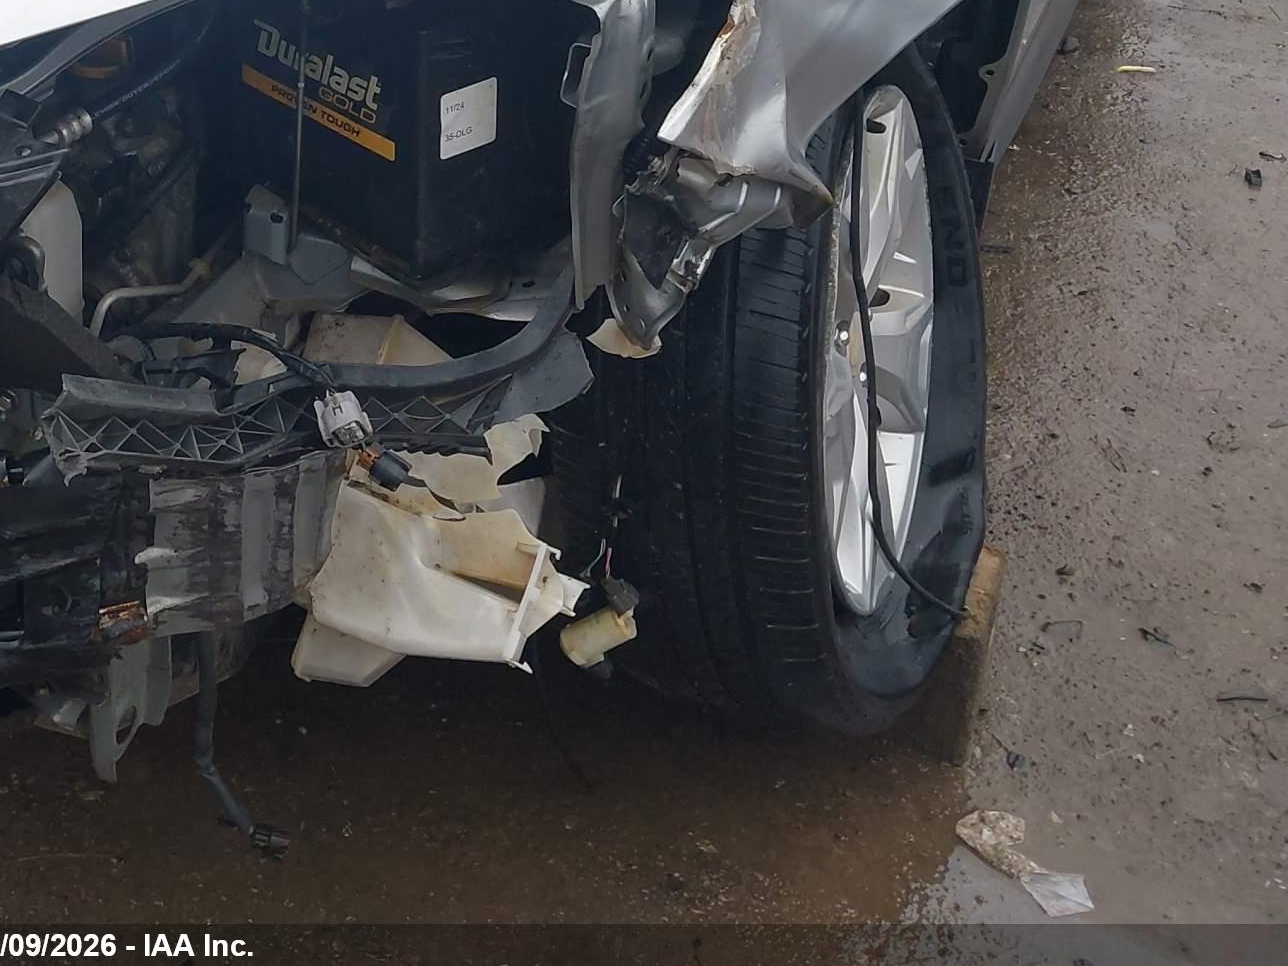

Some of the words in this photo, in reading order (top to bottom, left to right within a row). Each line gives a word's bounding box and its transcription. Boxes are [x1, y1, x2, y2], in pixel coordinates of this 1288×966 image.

[253, 18, 383, 111] Duralast
[318, 86, 376, 124] GOLD
[321, 110, 360, 138] TOUGH
